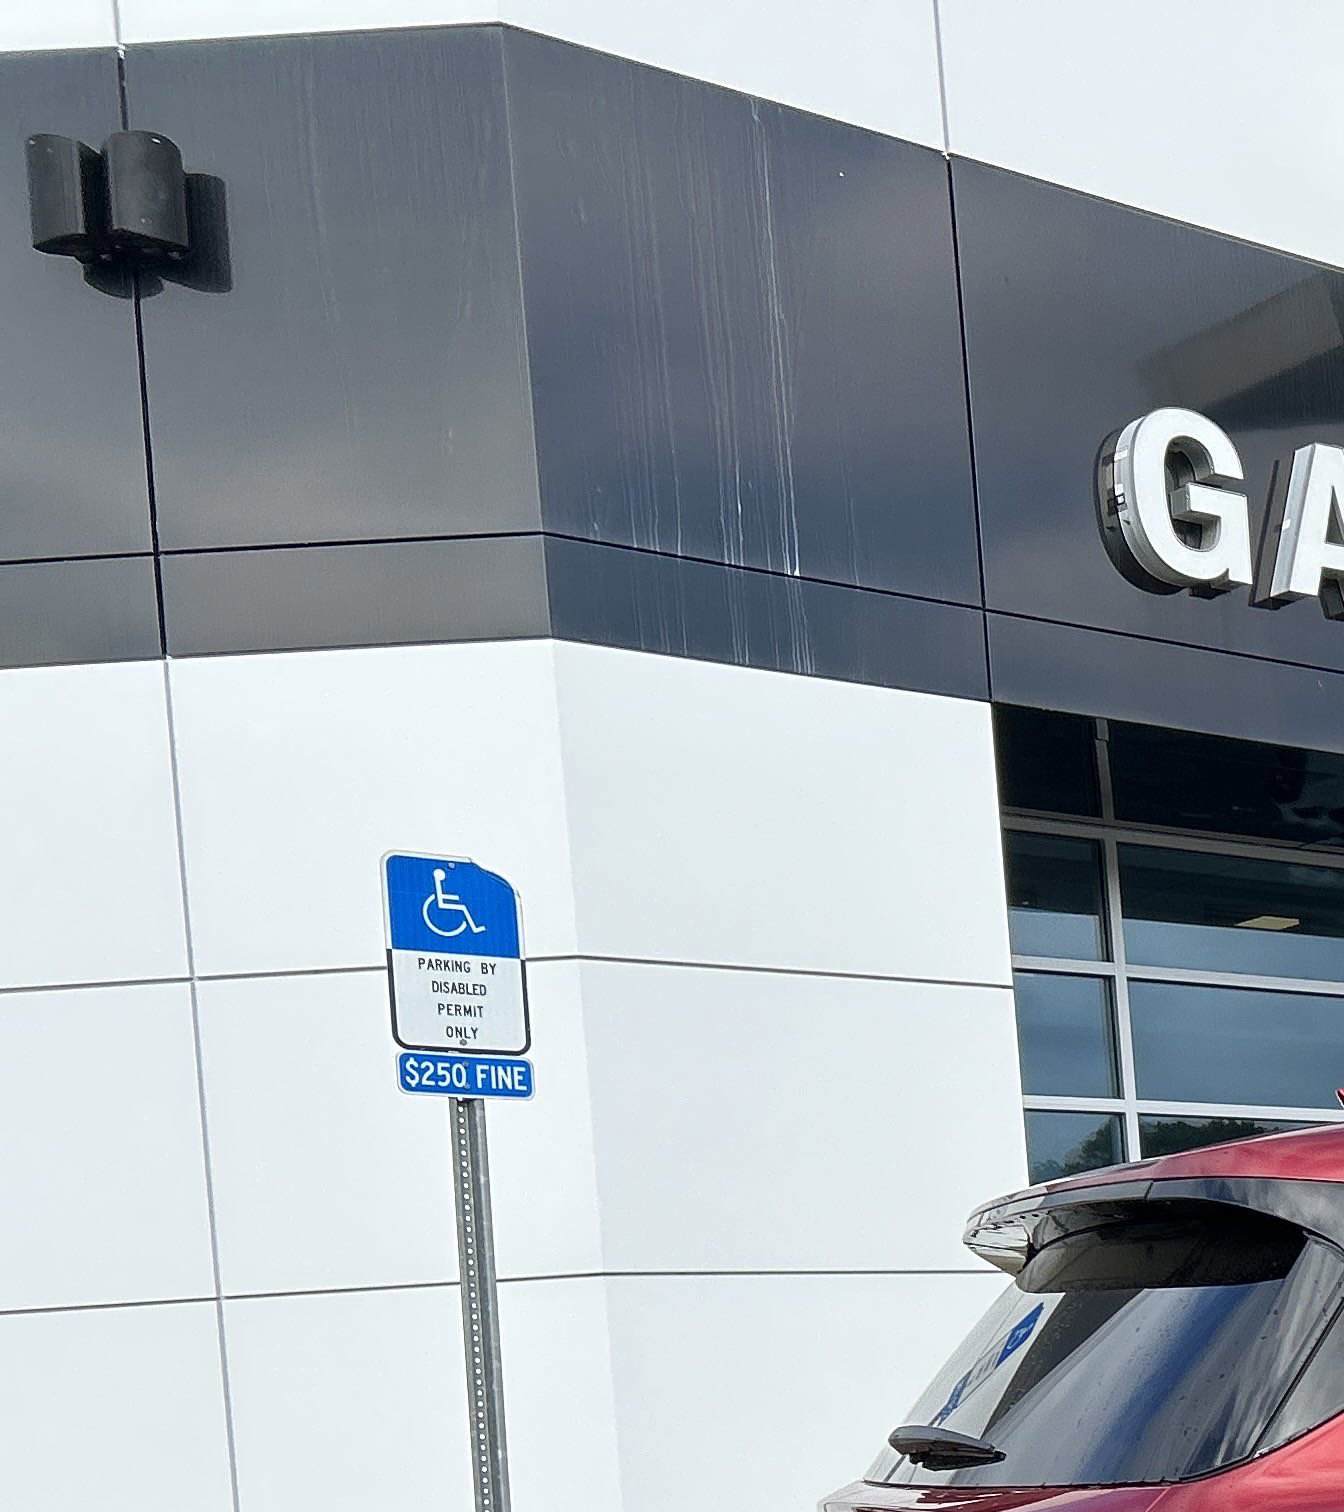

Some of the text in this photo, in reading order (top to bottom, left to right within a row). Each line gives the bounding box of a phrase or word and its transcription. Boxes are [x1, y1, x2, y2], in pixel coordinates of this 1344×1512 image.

[418, 957, 497, 976] PARKING BY
[432, 981, 487, 996] DISABLED
[438, 1004, 483, 1017] PERMIT
[446, 1026, 478, 1039] ONLY
[404, 1056, 528, 1091] $250 FINE
